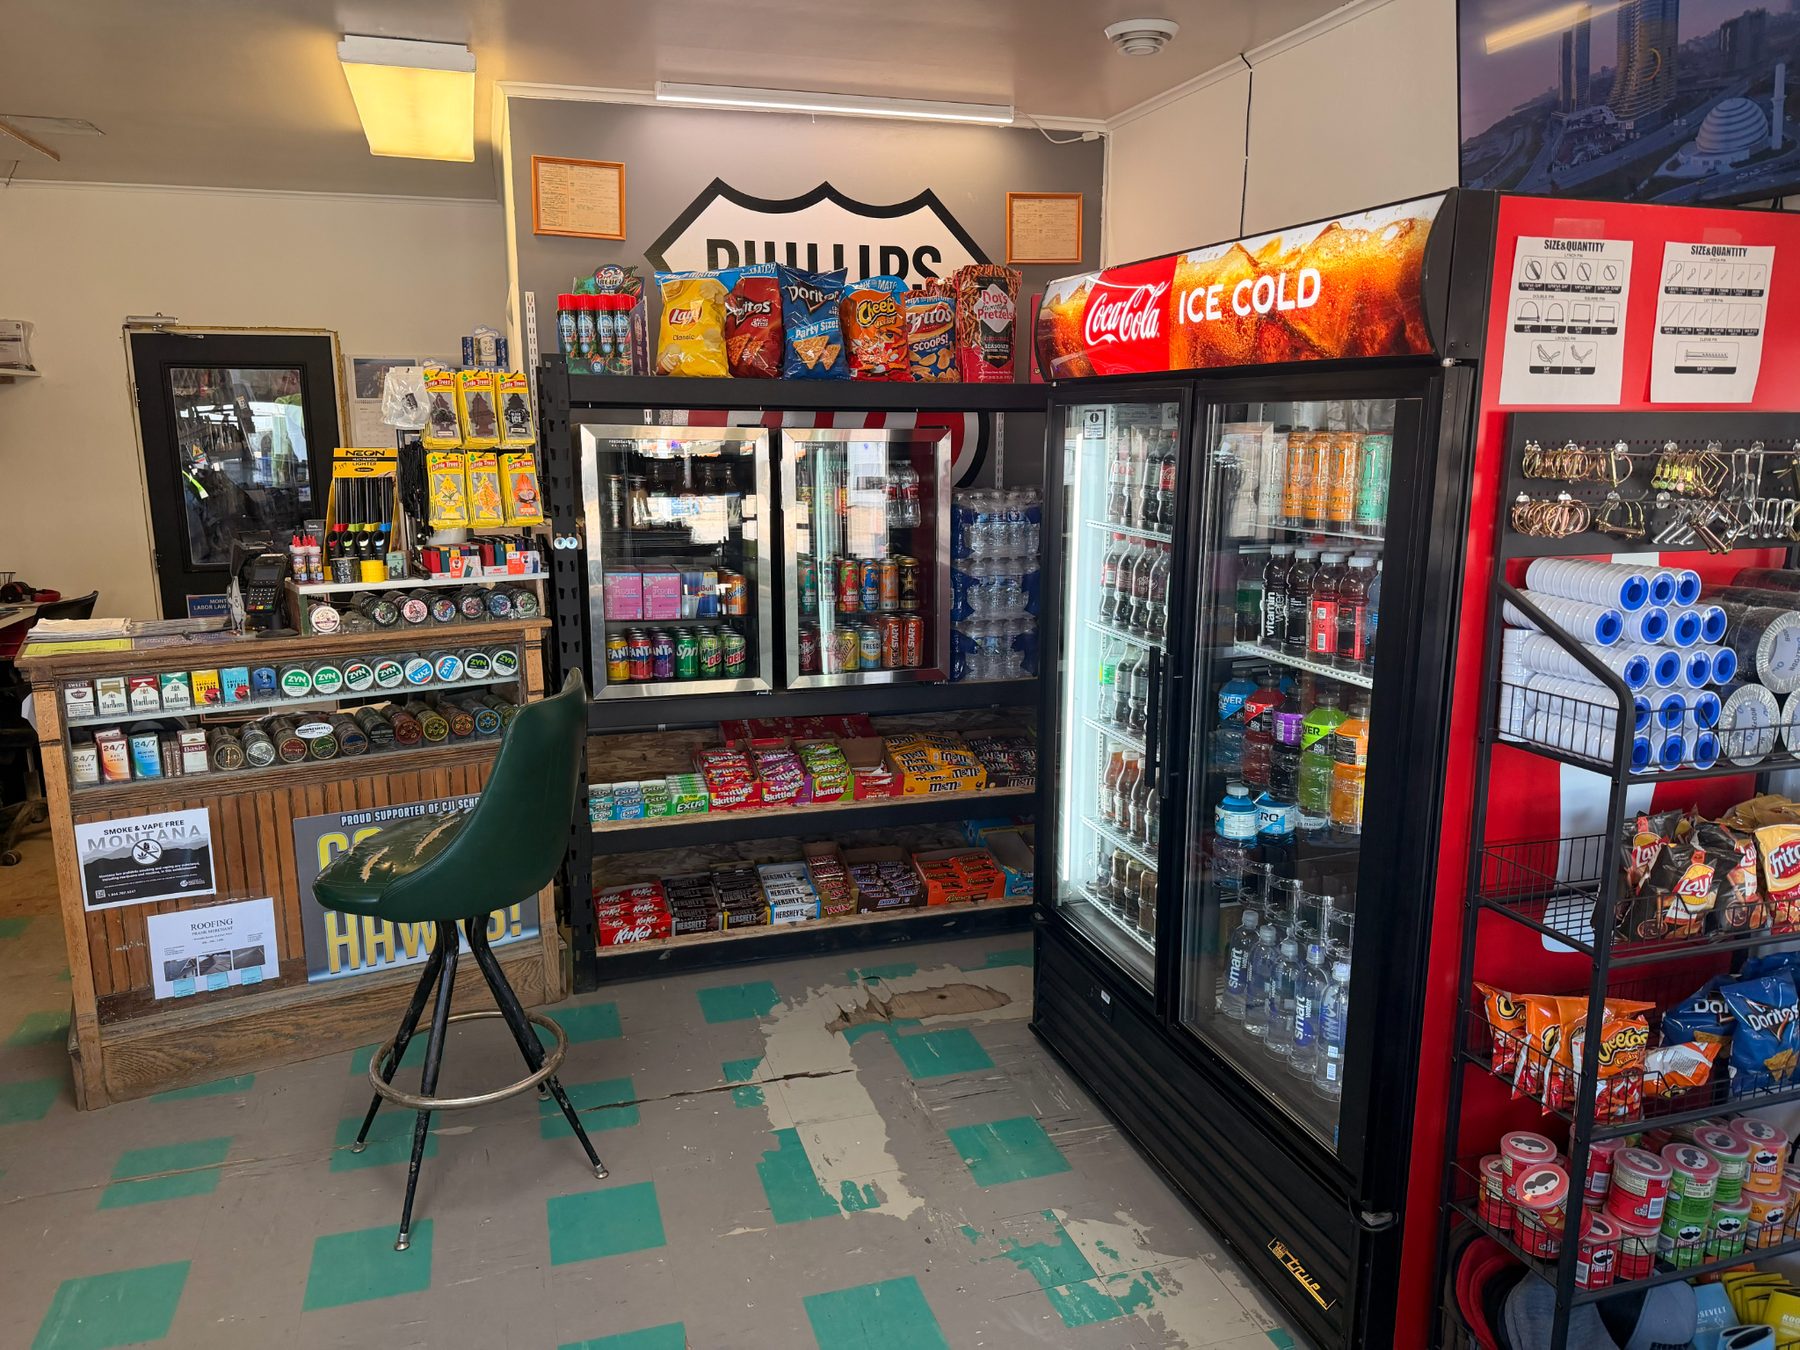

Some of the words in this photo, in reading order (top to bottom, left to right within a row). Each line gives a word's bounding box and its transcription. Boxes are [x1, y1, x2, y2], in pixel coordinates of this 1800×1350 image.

[1544, 240, 1605, 252] SIZE&QUANTITY
[1691, 245, 1748, 257] SIZE&QUANTITY
[983, 289, 1009, 304] Dot's
[1179, 287, 1222, 325] ICE
[1231, 268, 1322, 318] COLD
[977, 309, 1014, 320] Pretzels
[795, 324, 819, 339] Party
[820, 320, 840, 333] Size!
[913, 335, 949, 352] SCOOPS!
[1266, 592, 1275, 637] vitamin
[607, 646, 628, 659] FANT
[470, 658, 486, 666] ZYN
[500, 654, 515, 665] ZYN
[379, 666, 397, 677] ZYN
[441, 659, 452, 675] ZYN
[288, 675, 306, 683] ZYN
[318, 673, 336, 681] ZYN
[348, 669, 366, 680] ZYN
[413, 668, 431, 681] ZYN
[1218, 695, 1242, 706] OWER
[103, 743, 125, 752] 24/7
[134, 739, 156, 748] 24/7
[183, 745, 206, 753] Basic
[73, 754, 96, 763] 24/7
[764, 791, 797, 802] Skittles
[815, 786, 845, 797] Skittles
[677, 800, 705, 812] Extra
[712, 796, 746, 807] Skittles
[341, 813, 372, 826] PROUD
[375, 805, 425, 822] SUPPORTER
[428, 803, 440, 814] OF
[442, 801, 455, 812] CJI
[1258, 812, 1279, 823] RO
[104, 826, 133, 836] SMOKE
[142, 822, 164, 831] VAPE
[88, 825, 200, 851] MONTANA
[1768, 845, 1800, 878] Frito
[770, 888, 801, 896] HERSHEY'S
[775, 908, 804, 918] HERSHEY'S
[191, 918, 233, 931] ROOFING
[676, 919, 707, 930] HERSHEY'S
[1228, 947, 1242, 988] smart
[1294, 996, 1305, 1040] smart
[1753, 1163, 1777, 1174] PRINGLES
[1698, 1306, 1727, 1319] SEVELT
